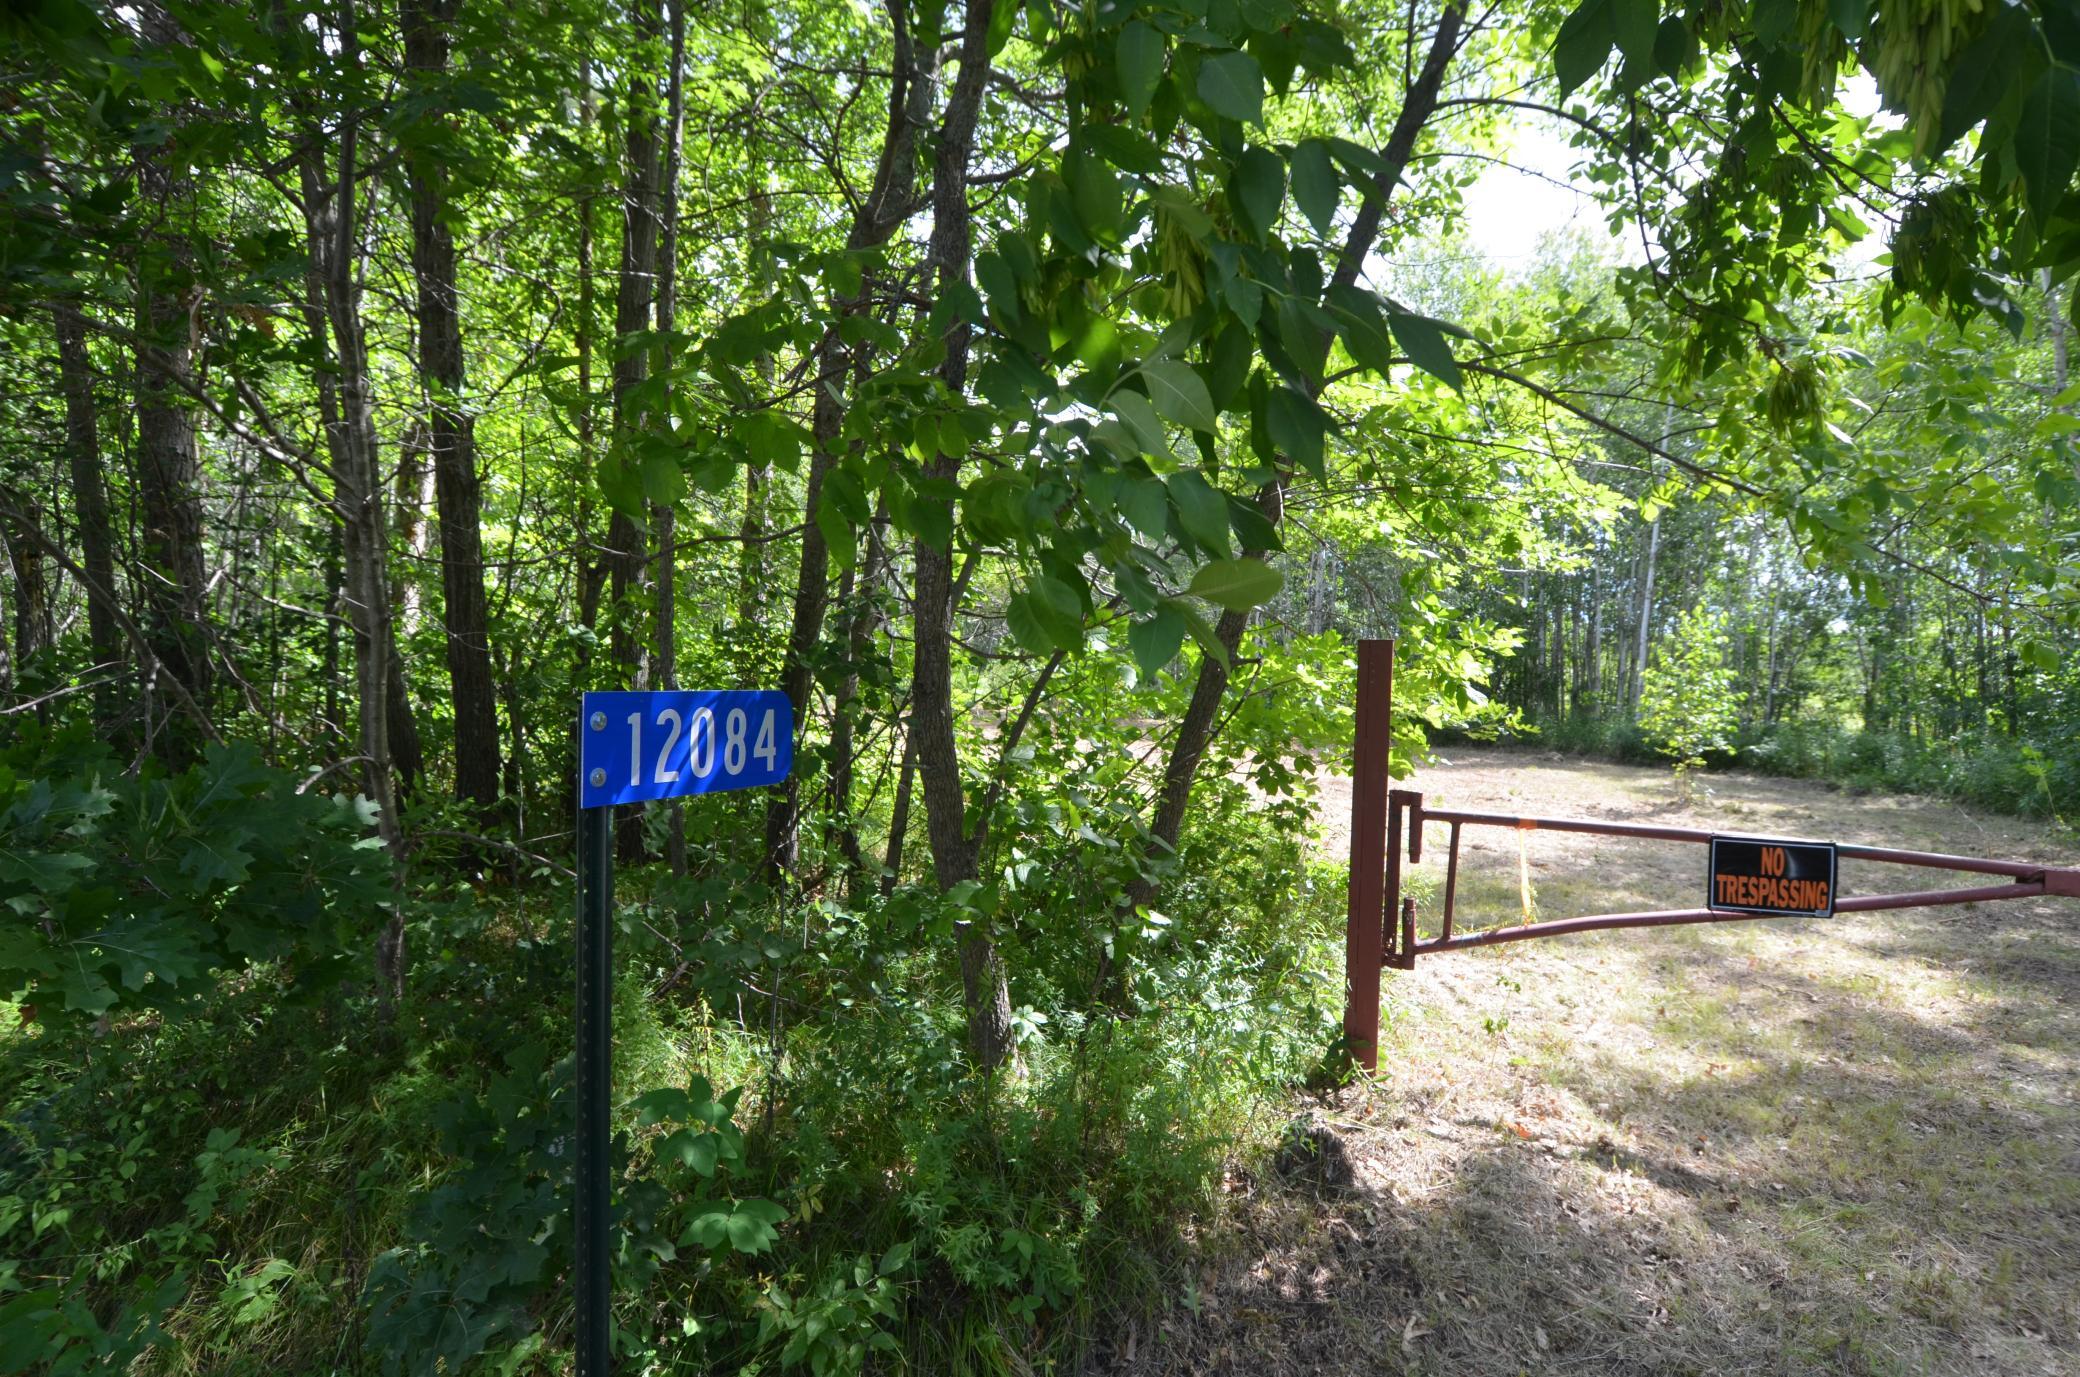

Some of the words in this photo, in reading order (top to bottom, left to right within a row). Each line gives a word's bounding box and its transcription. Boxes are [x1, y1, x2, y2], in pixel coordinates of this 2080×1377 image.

[627, 707, 776, 787] 12084
[1761, 847, 1785, 877] NO
[1716, 874, 1828, 911] TRESPASSING
